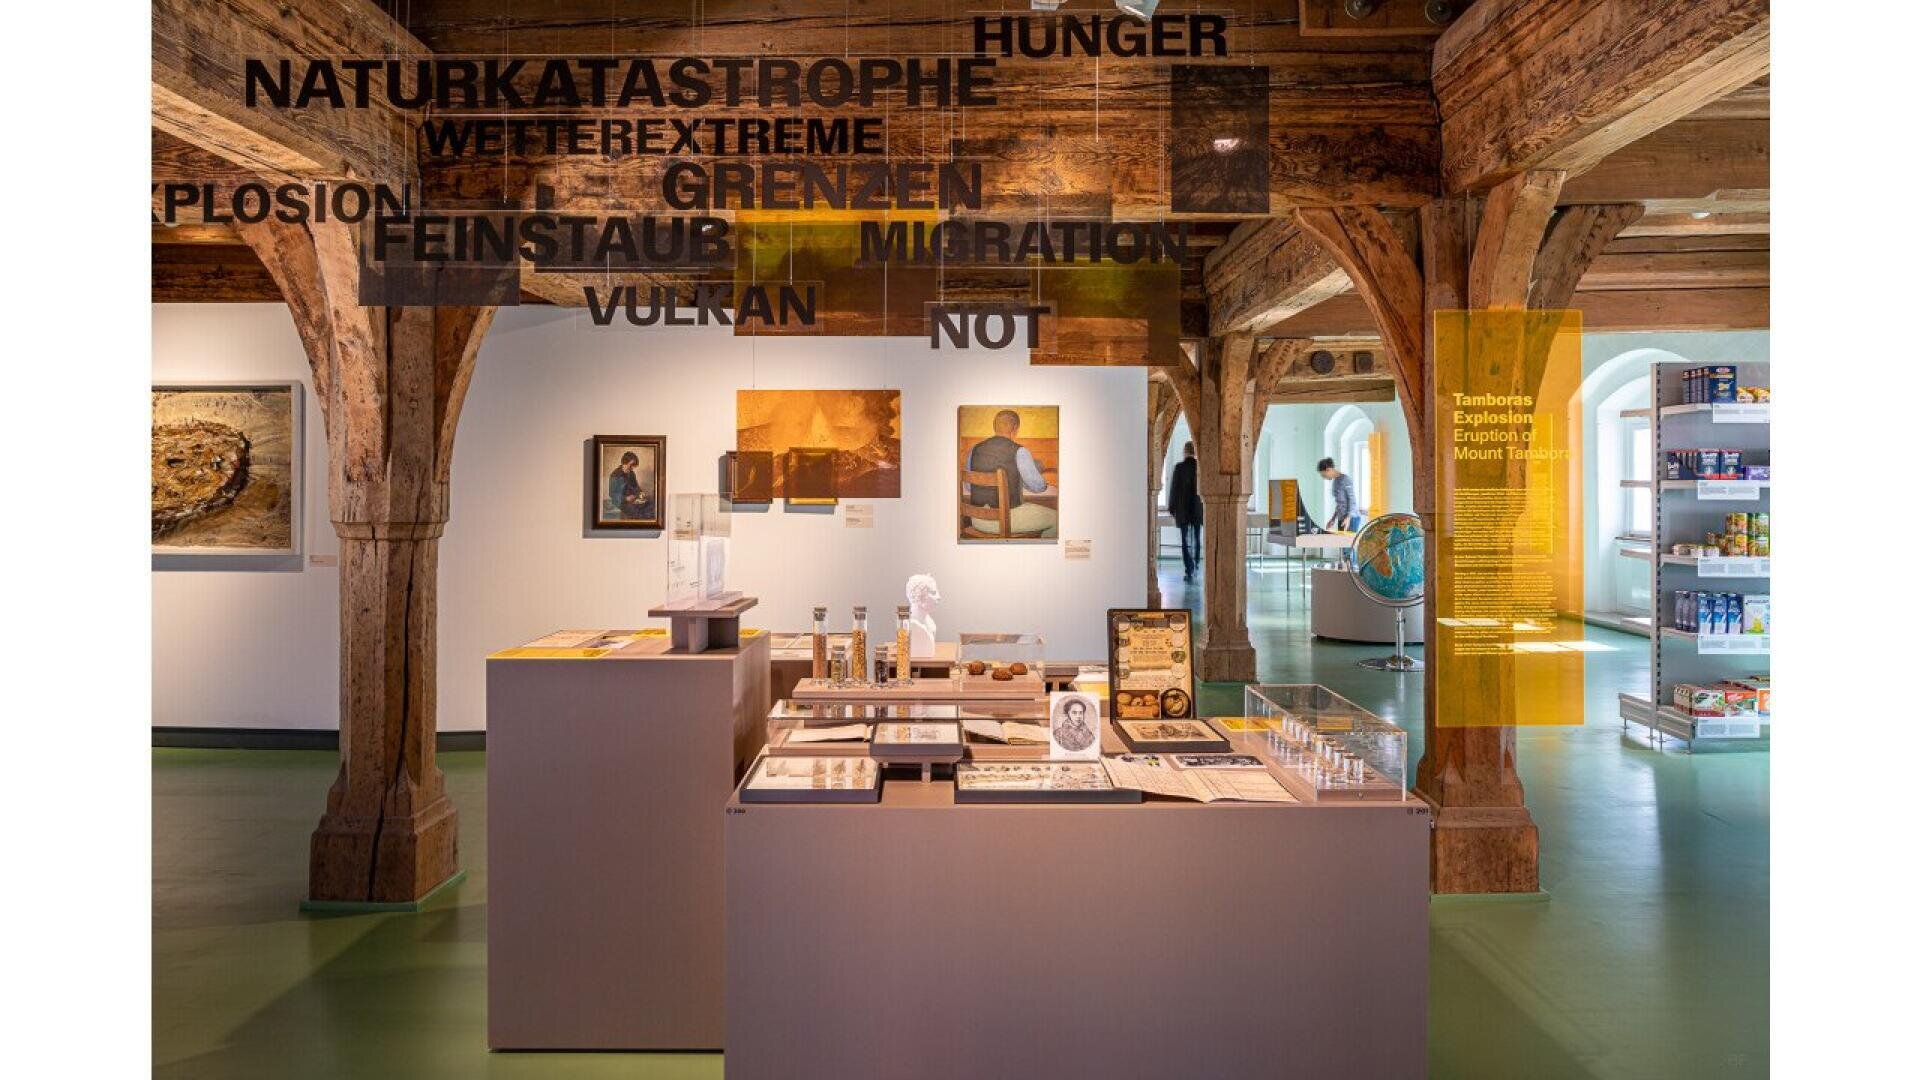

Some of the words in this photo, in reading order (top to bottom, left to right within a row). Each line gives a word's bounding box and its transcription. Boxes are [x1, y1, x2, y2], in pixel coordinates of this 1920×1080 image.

[974, 13, 1228, 58] HUNGER
[245, 57, 998, 109] NATURKATASTROPHE
[423, 117, 884, 157] WETTEREXTREME
[662, 161, 982, 212] GRENZEN
[374, 214, 731, 265] FEINSTAUB
[860, 219, 1189, 266] MIGRATION
[584, 285, 818, 327] VULKAN
[930, 306, 1051, 351] NOT
[1453, 392, 1533, 406] Tamboras
[1454, 410, 1533, 427] Explosion
[1454, 428, 1518, 445] Eruption
[1522, 428, 1538, 442] of
[1454, 446, 1503, 460] Mount
[1506, 446, 1571, 460] Tambora
